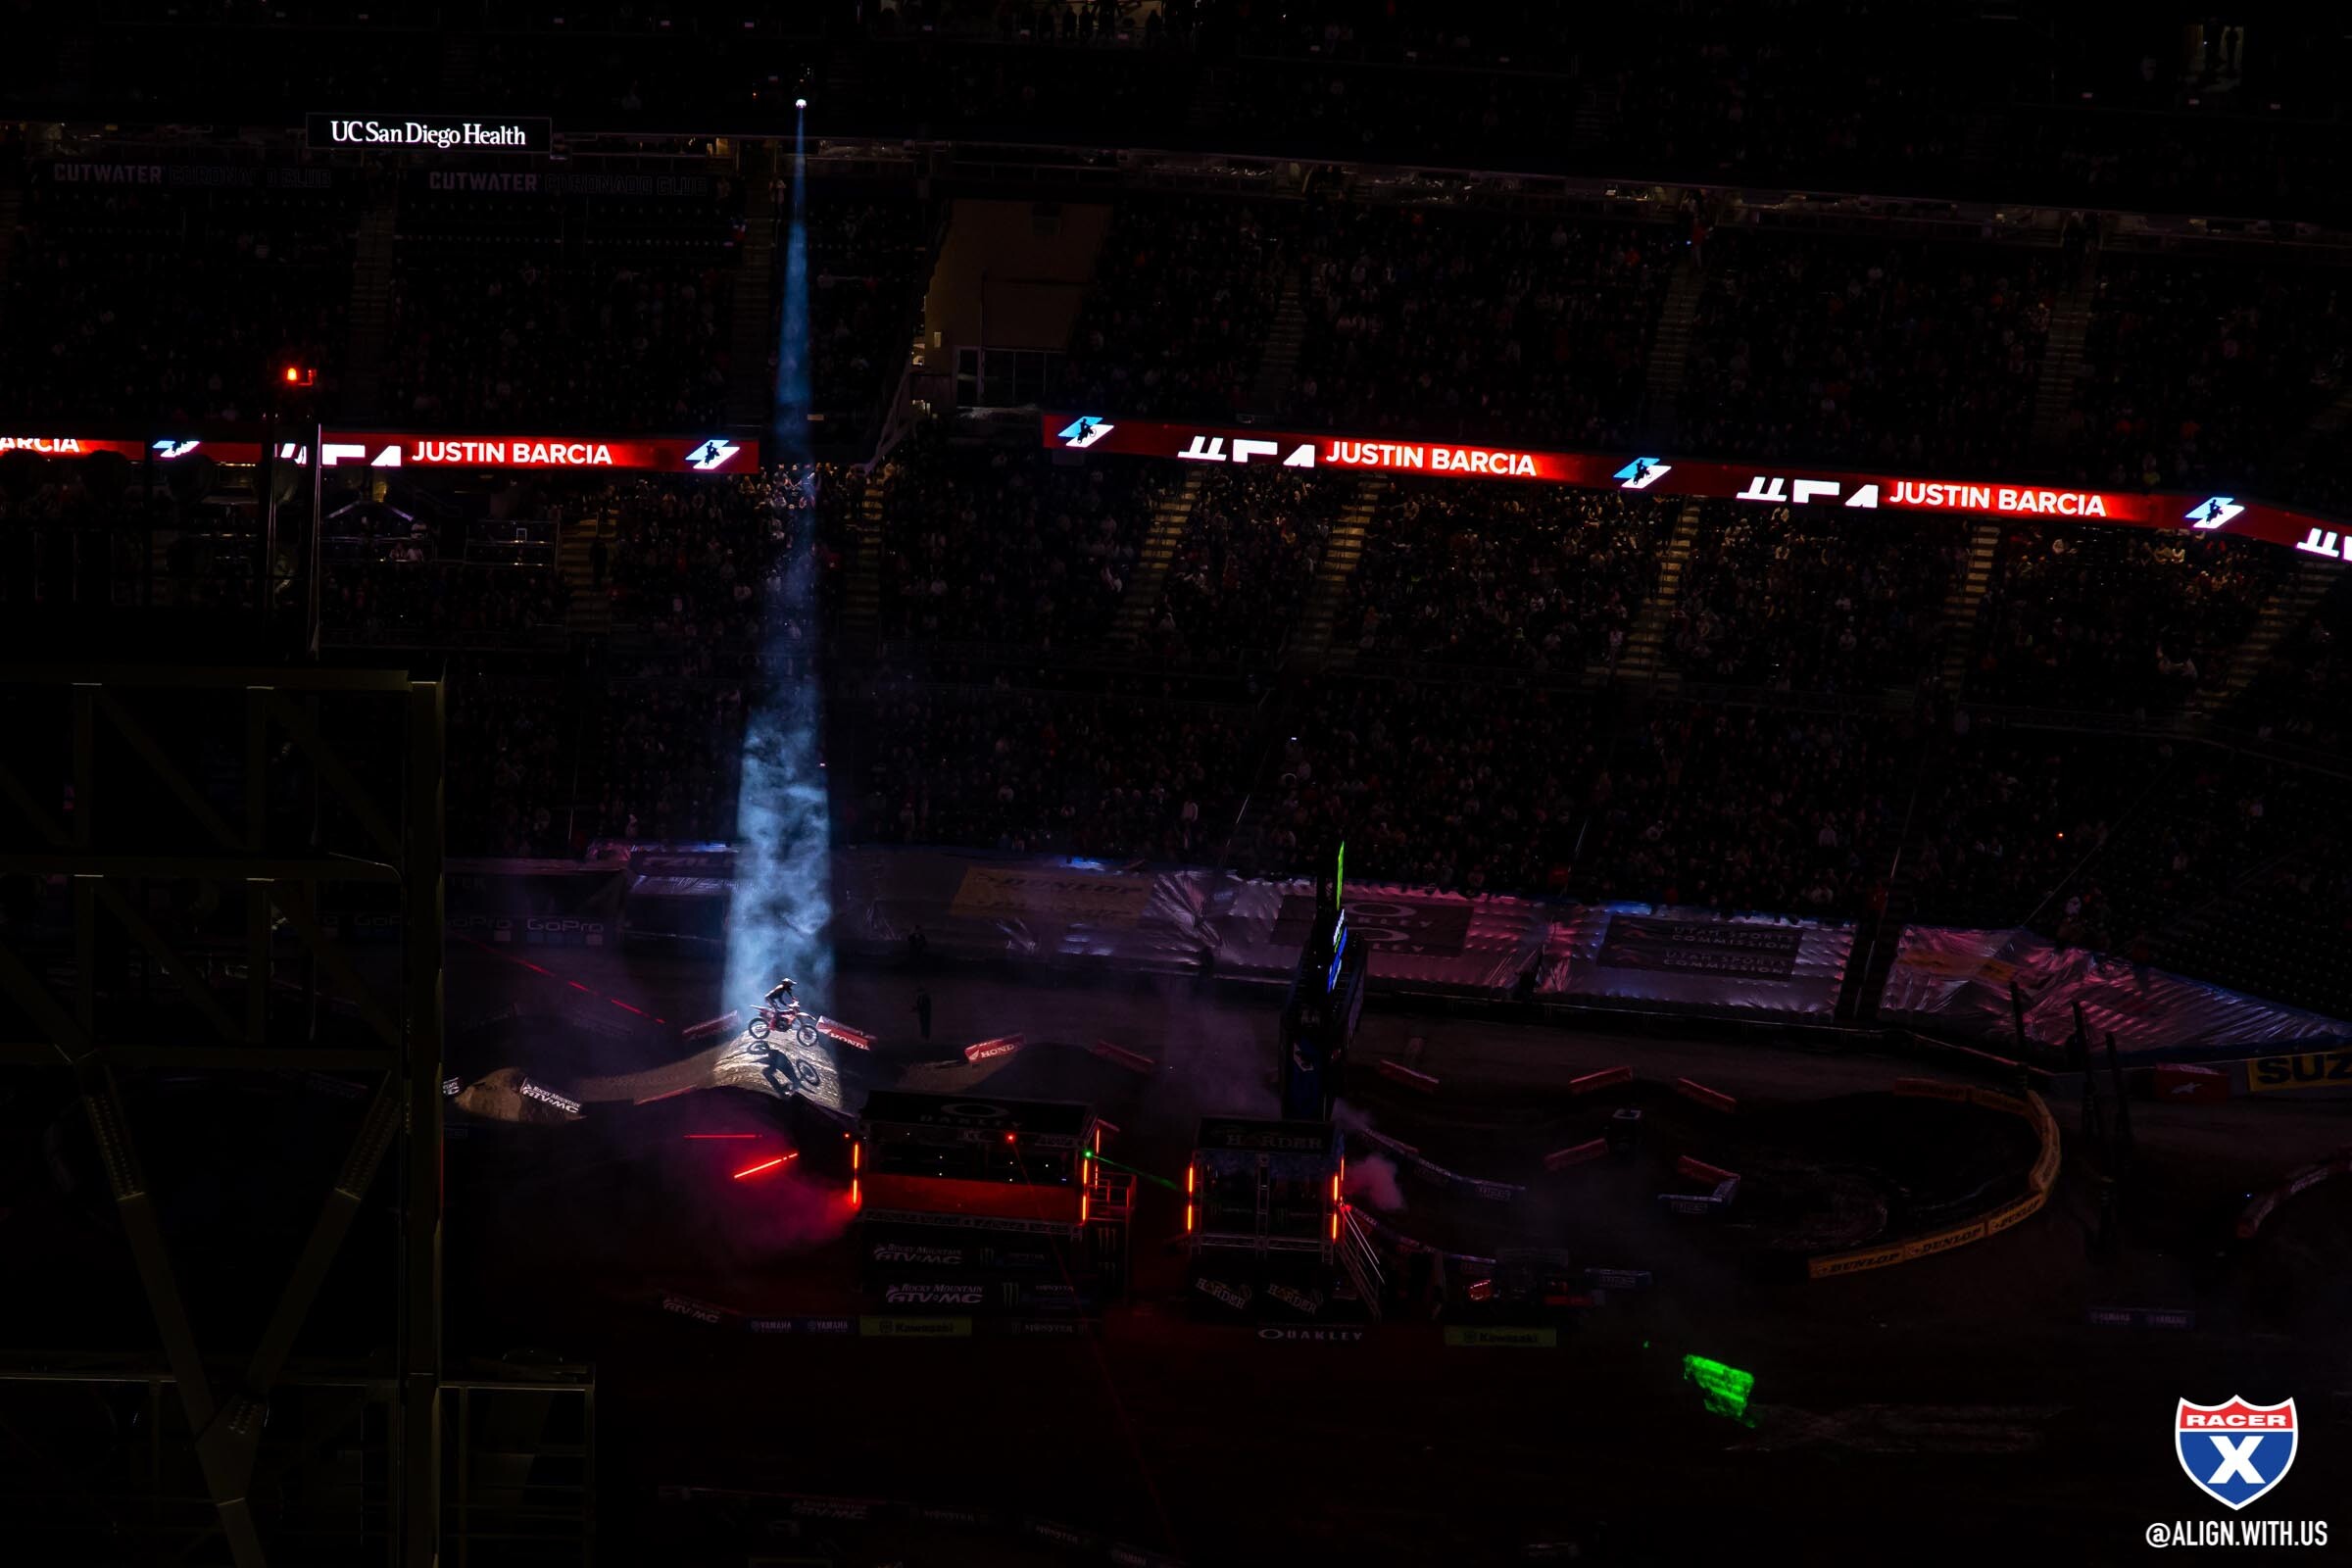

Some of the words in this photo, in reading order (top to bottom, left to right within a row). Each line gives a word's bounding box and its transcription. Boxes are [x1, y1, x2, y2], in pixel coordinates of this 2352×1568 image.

[329, 120, 364, 142] UC
[365, 121, 403, 143] San
[405, 122, 462, 148] Diego
[462, 122, 526, 145] Health
[54, 163, 162, 184] CUTWATER
[428, 172, 537, 191] CUTWATER
[412, 441, 505, 463] JUSTIN
[513, 443, 612, 465] BARCIA
[1325, 441, 1424, 467] JUSTIN
[1431, 448, 1538, 476] BARCIA
[1889, 481, 1990, 509] JUSTIN
[1997, 489, 2107, 516] BARCIA
[526, 918, 605, 933] GoPro
[1923, 1228, 1982, 1252] DUNLOP
[1830, 1252, 1900, 1273] DUNLOP
[901, 1284, 931, 1295] ROCKY
[932, 1284, 984, 1295] MOUNTAIN
[760, 1320, 792, 1332] YAMAHA
[815, 1320, 848, 1332] YAMAHA
